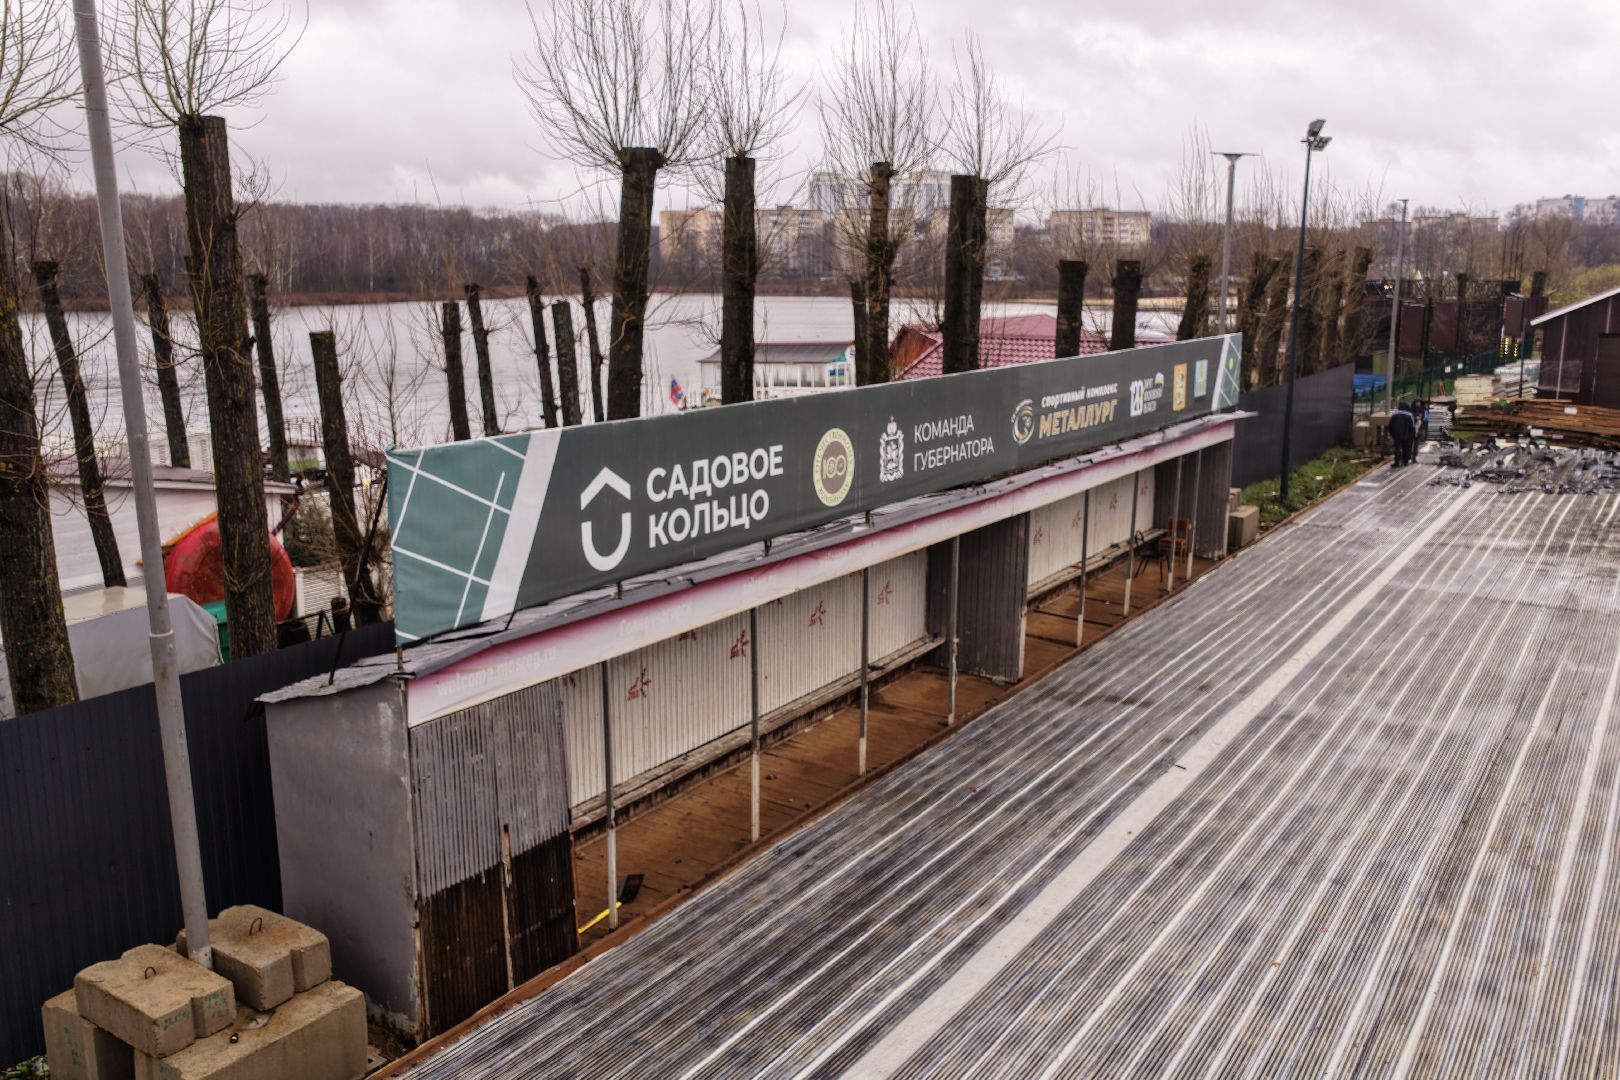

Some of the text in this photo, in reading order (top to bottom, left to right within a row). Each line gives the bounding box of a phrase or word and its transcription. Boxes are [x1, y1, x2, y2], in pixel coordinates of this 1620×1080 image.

[914, 415, 975, 443] КОМАНДА
[1039, 399, 1118, 439] МЕТАЛЛУРГ
[646, 444, 783, 502] САДОВОЕ
[914, 437, 994, 472] ГУБЕРНАТОРА
[649, 489, 769, 549] КОЛЬЦО
[437, 646, 558, 697] welcome.mosreg.ru
